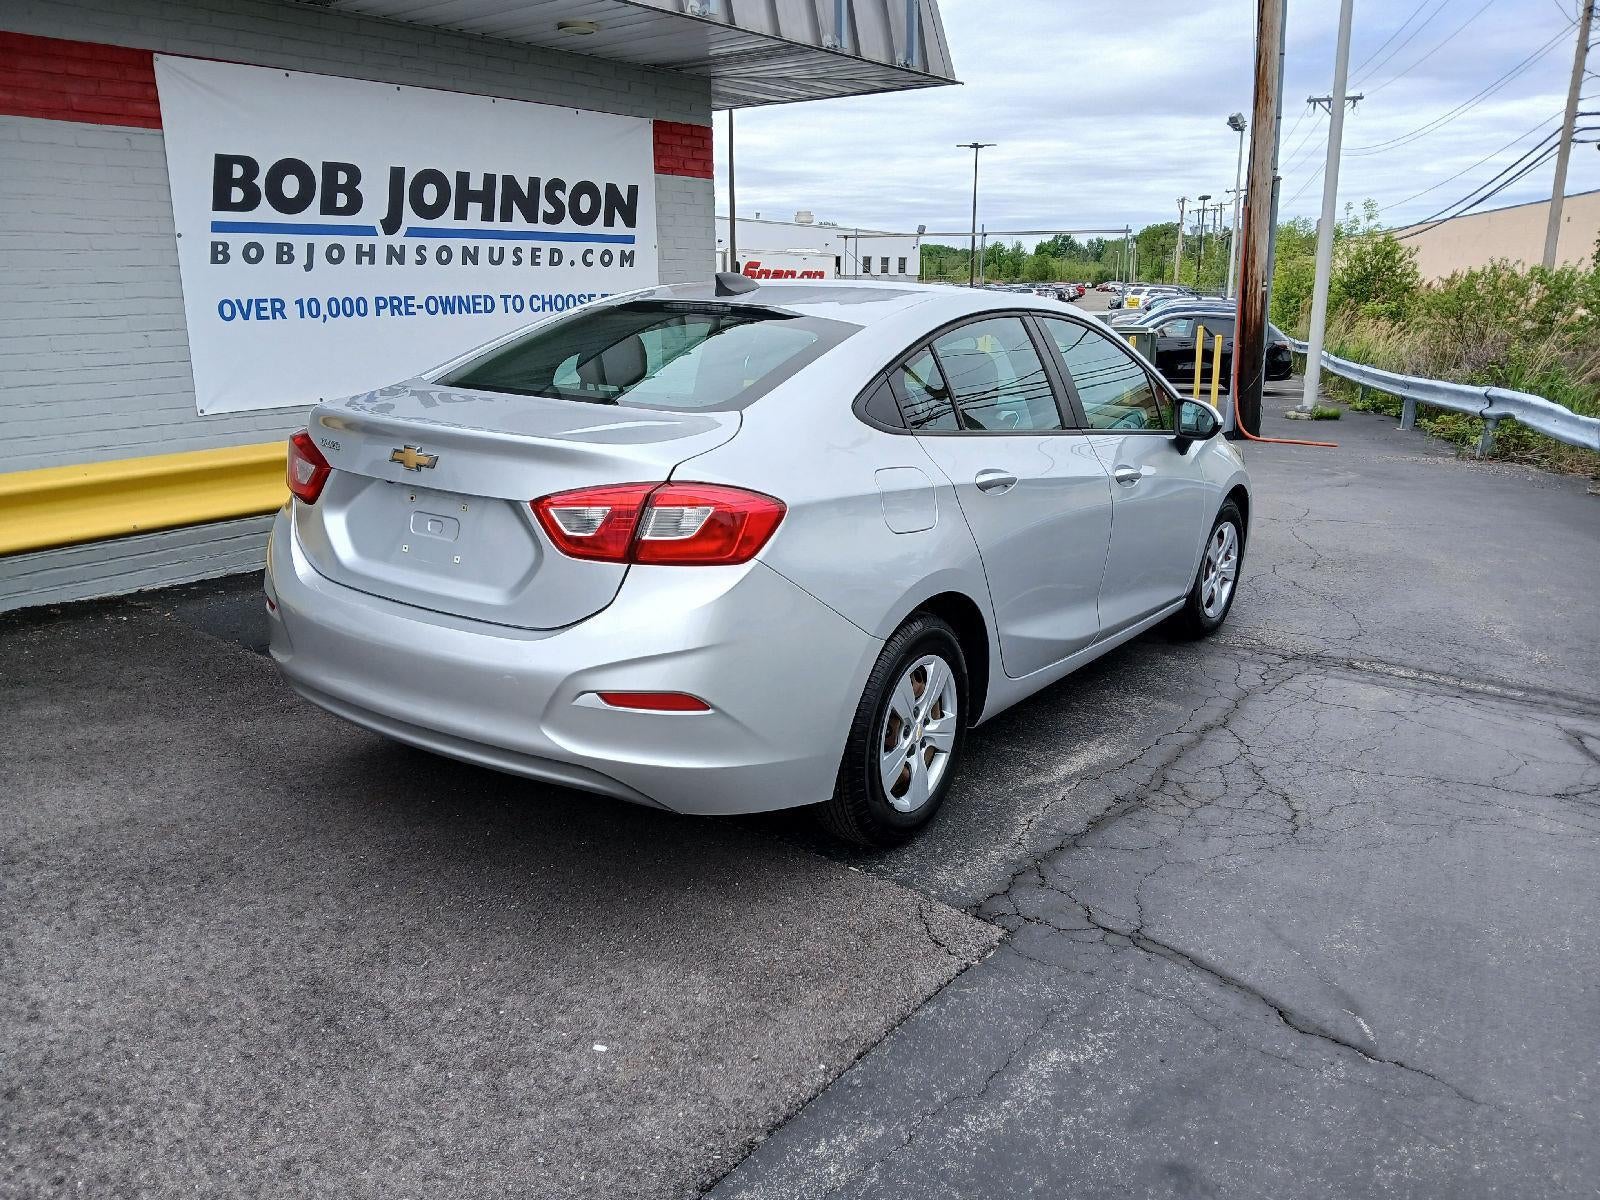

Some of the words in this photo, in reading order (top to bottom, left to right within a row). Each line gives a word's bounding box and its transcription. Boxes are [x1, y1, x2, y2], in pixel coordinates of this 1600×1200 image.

[211, 153, 364, 217] BOB
[380, 166, 639, 236] JOHNSON
[210, 241, 636, 273] BOBJOHNSONUSED.COM
[217, 298, 288, 322] OVER
[294, 296, 369, 323] 10,000
[375, 294, 496, 317] PRE-OWNED
[500, 294, 525, 314] TO
